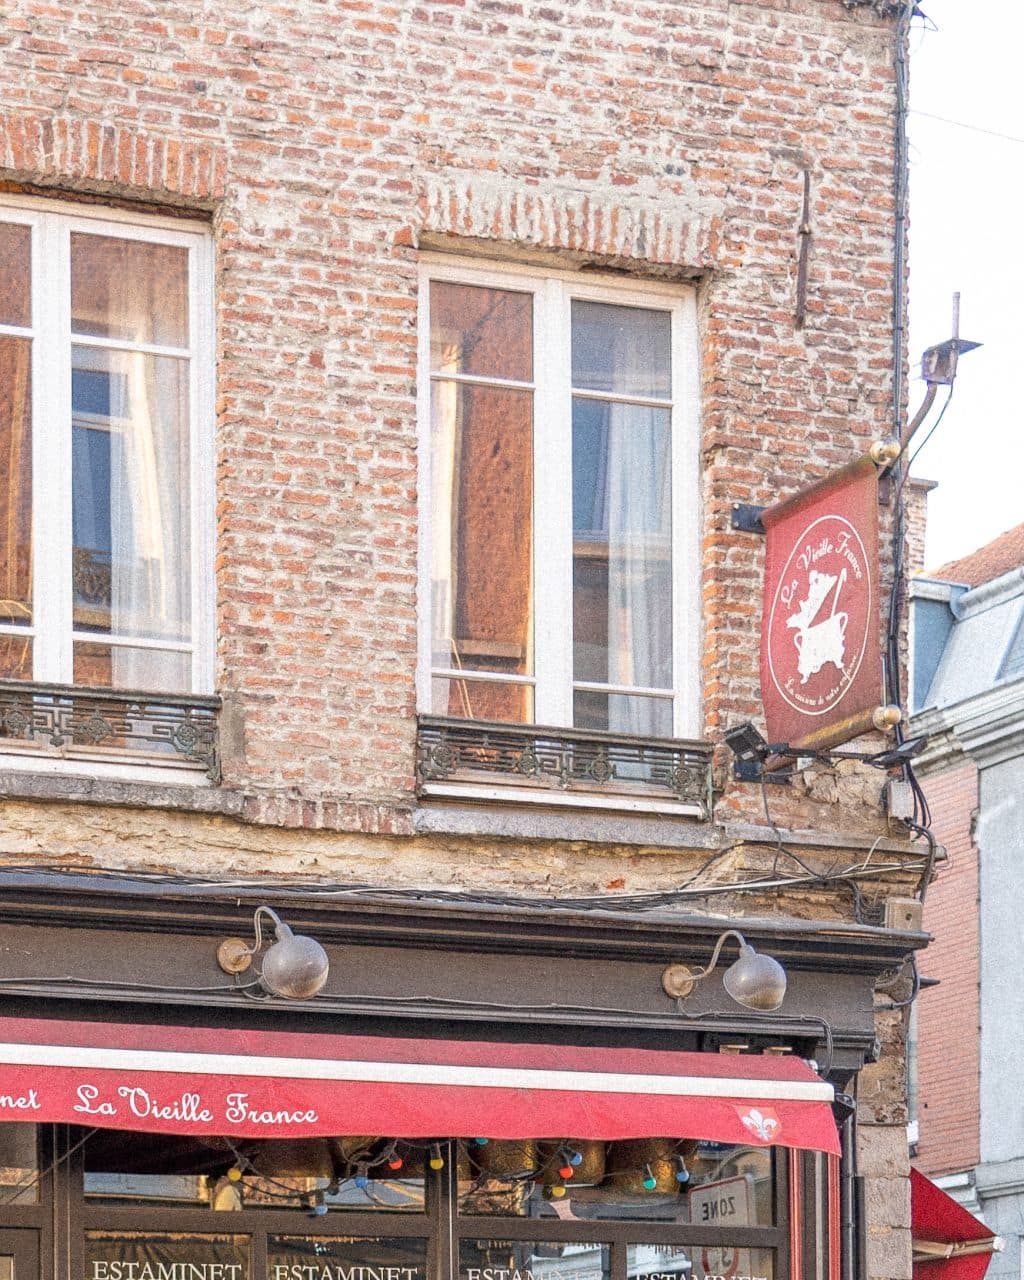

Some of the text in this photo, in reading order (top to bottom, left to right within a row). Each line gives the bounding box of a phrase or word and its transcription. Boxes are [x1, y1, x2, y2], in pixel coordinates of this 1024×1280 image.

[781, 531, 862, 609] La Vieille France
[73, 1085, 117, 1116] La
[118, 1086, 213, 1123] Vieille
[225, 1092, 319, 1124] France
